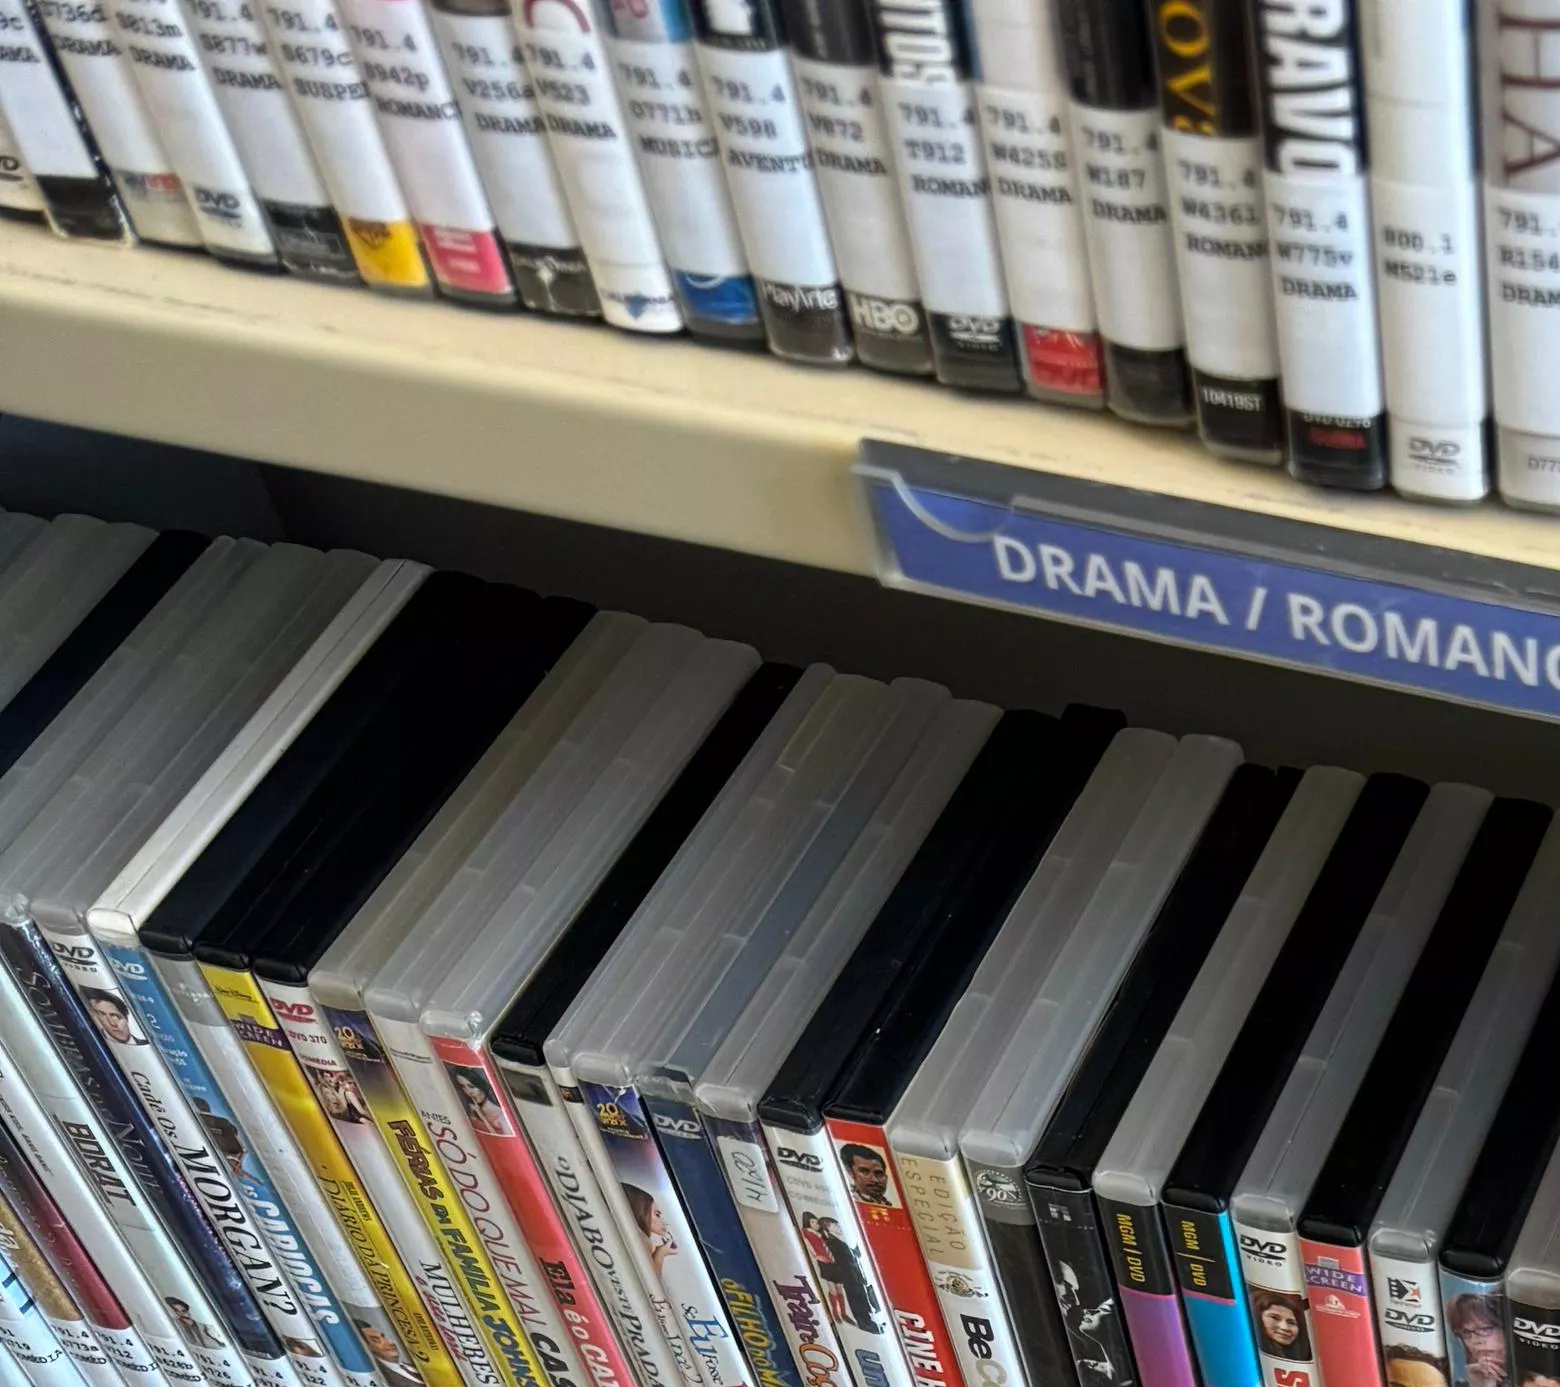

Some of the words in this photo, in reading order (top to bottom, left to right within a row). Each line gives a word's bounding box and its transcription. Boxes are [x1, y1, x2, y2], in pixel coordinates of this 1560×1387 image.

[129, 46, 196, 71] DRAMA
[212, 67, 282, 90] DRAMA
[712, 76, 785, 103] 791.4
[802, 79, 872, 107] 791.4
[550, 114, 616, 138] DRAMA
[985, 104, 1060, 133] 791.4
[904, 140, 967, 165] T912
[1082, 127, 1159, 155] 791.4
[817, 149, 886, 176] DRAMA
[1178, 161, 1256, 188] 791.4
[997, 177, 1073, 205] DRAMA
[1092, 198, 1167, 224] DRAMA
[1272, 203, 1348, 230] 791.4
[1282, 275, 1357, 301] DRAMA
[854, 295, 919, 335] HBO
[991, 531, 1231, 628] DRAMA
[1247, 586, 1268, 631] /
[387, 1119, 444, 1201] FÉRIAS
[555, 1167, 615, 1272] DIABO
[901, 1157, 945, 1256] ESPECIAL
[929, 1174, 967, 1251] EDIÇÃO
[174, 1145, 298, 1316] MORGAN?
[250, 1199, 341, 1326] CARIOCAS
[540, 1256, 577, 1306] Ela
[370, 1268, 423, 1347] PRINCESA
[418, 1260, 501, 1385] MULHERES
[960, 1313, 995, 1360] Be
[893, 1308, 945, 1375] CINE
